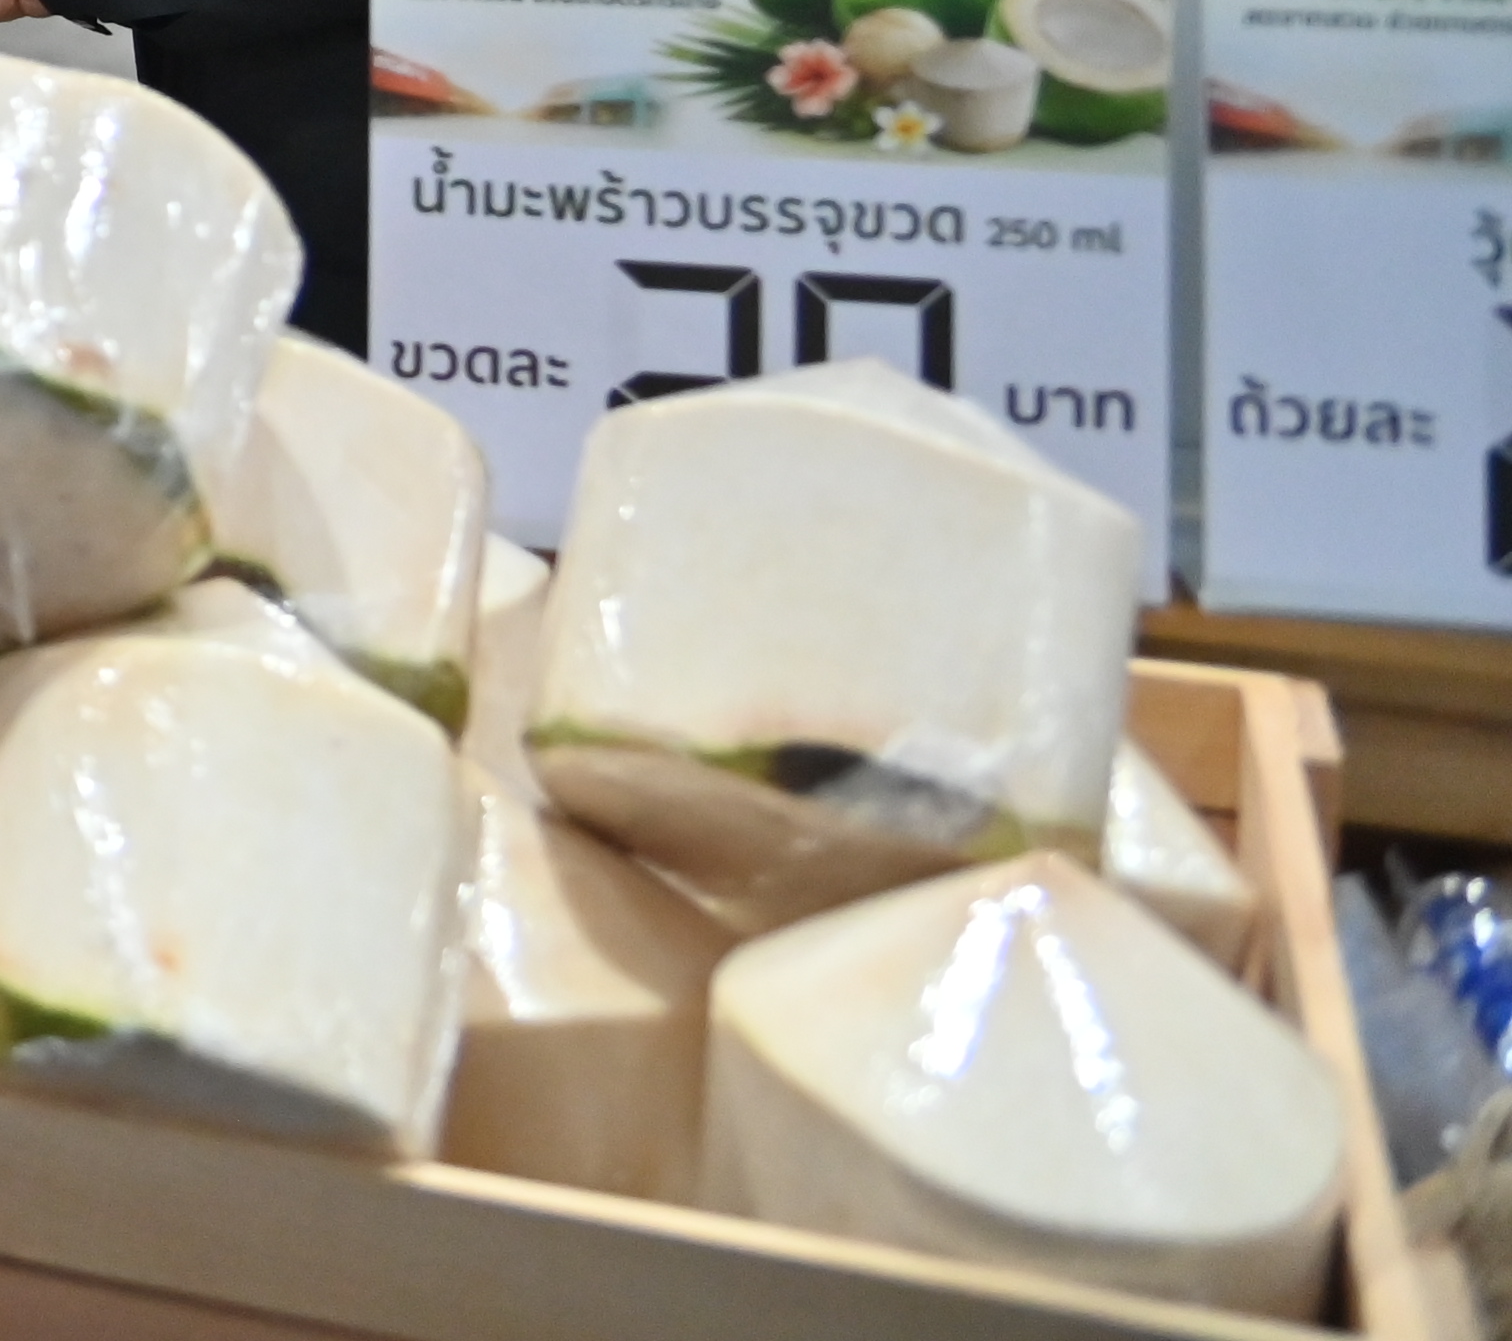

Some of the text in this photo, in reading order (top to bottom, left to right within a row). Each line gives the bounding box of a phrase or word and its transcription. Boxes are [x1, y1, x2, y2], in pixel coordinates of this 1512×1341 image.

[410, 146, 1126, 255] น้ำมะพร้าวบรรจุขวด 250 ml
[390, 336, 572, 391] ขวดละ
[1006, 380, 1138, 433] บาท
[1228, 373, 1436, 451] ถ้วยละ
